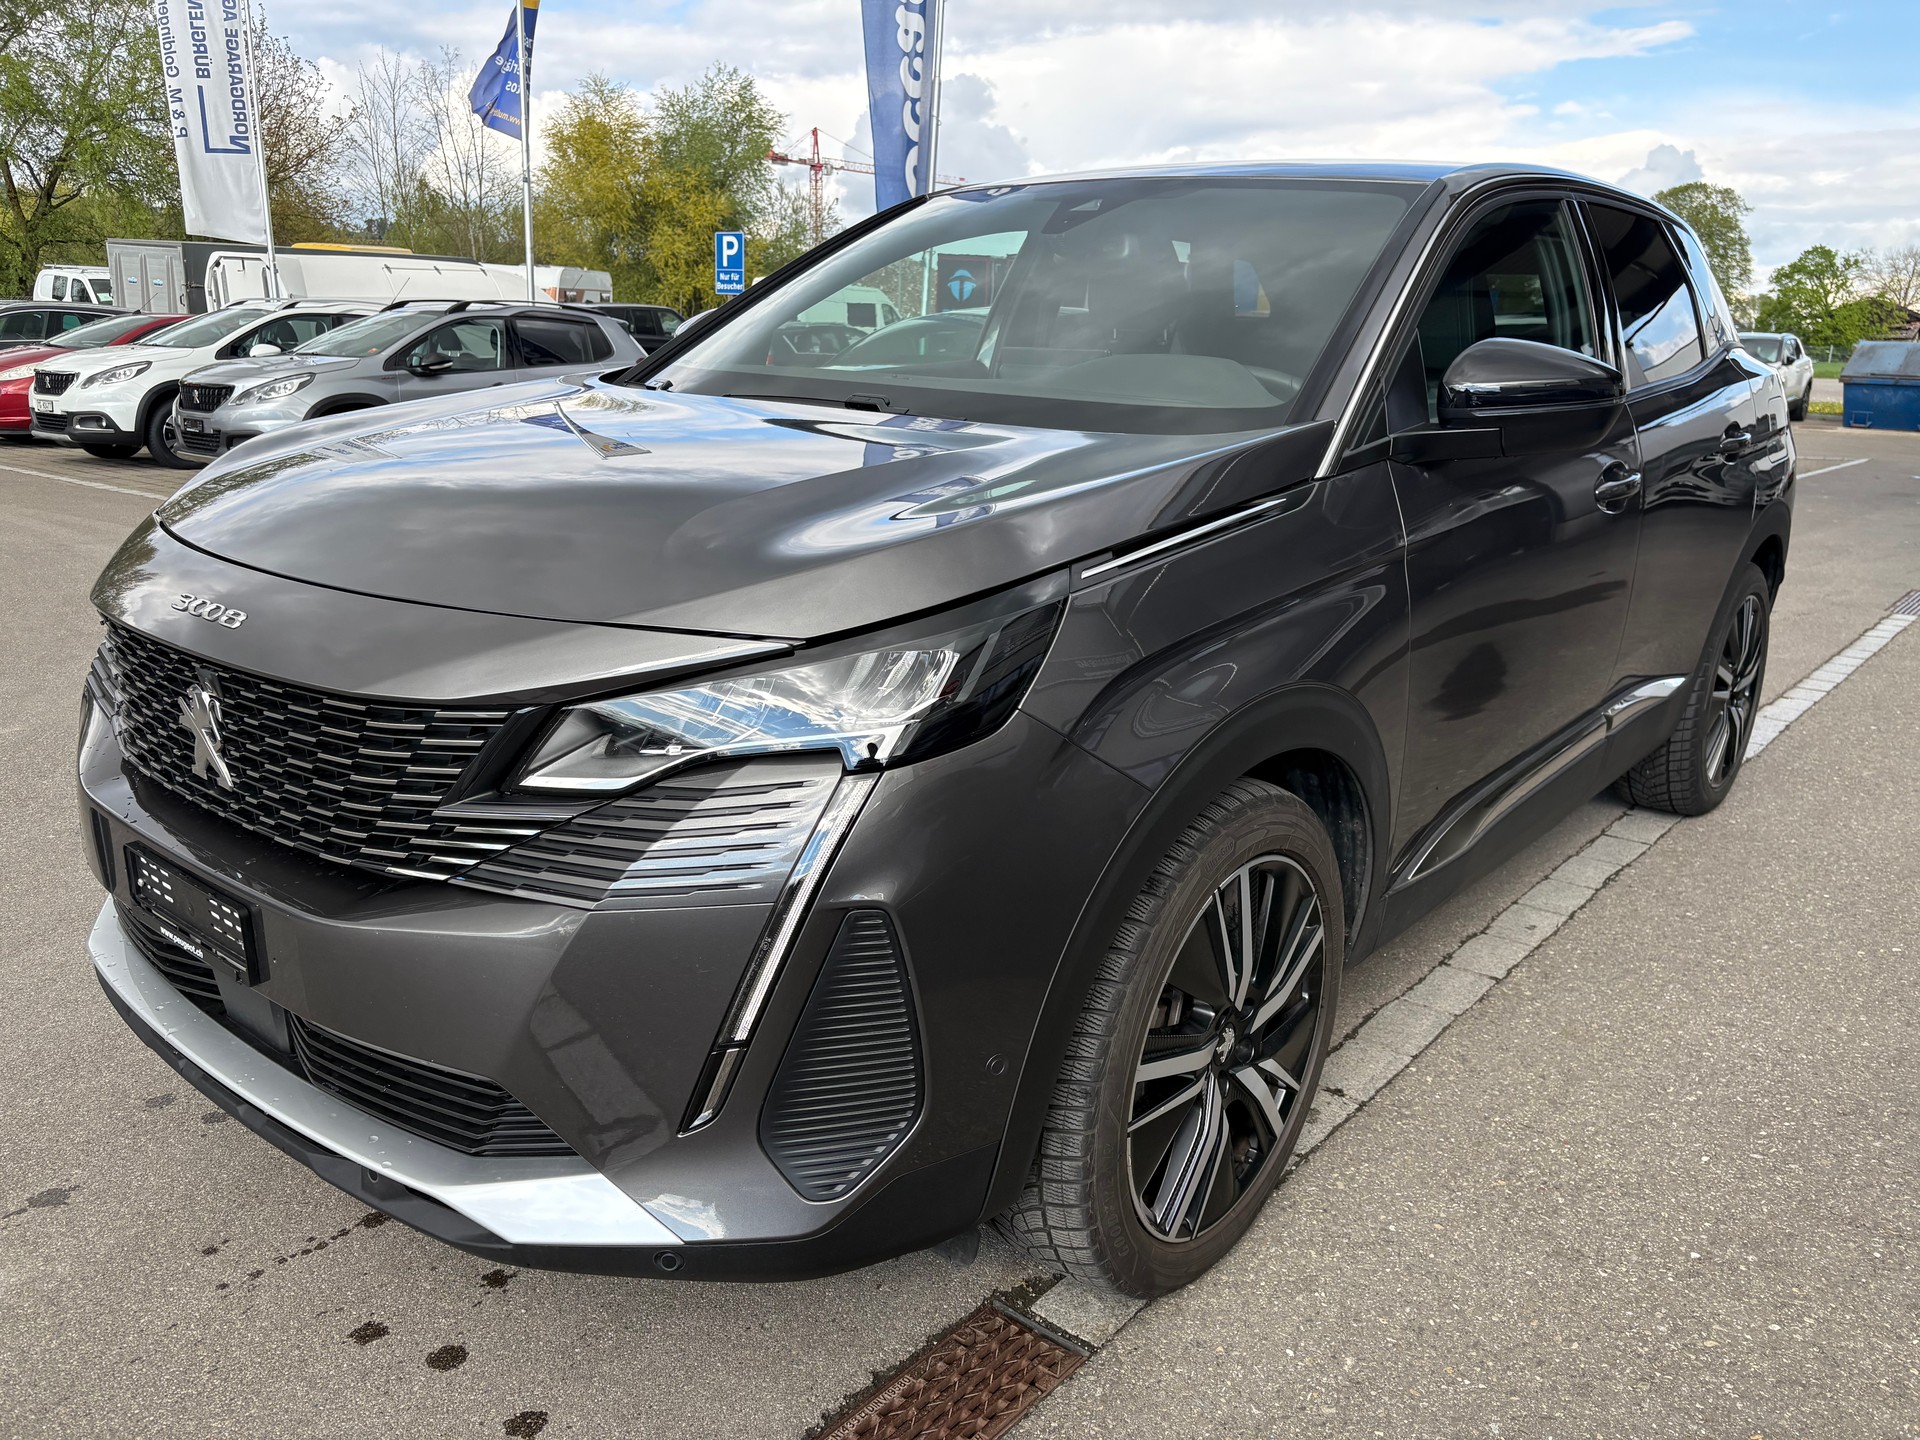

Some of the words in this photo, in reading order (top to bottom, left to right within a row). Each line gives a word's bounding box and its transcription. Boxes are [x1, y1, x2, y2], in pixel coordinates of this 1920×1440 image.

[722, 235, 739, 267] P
[716, 282, 744, 290] Besucher
[719, 272, 731, 281] Nur
[731, 272, 741, 281] für
[171, 593, 248, 630] 3008
